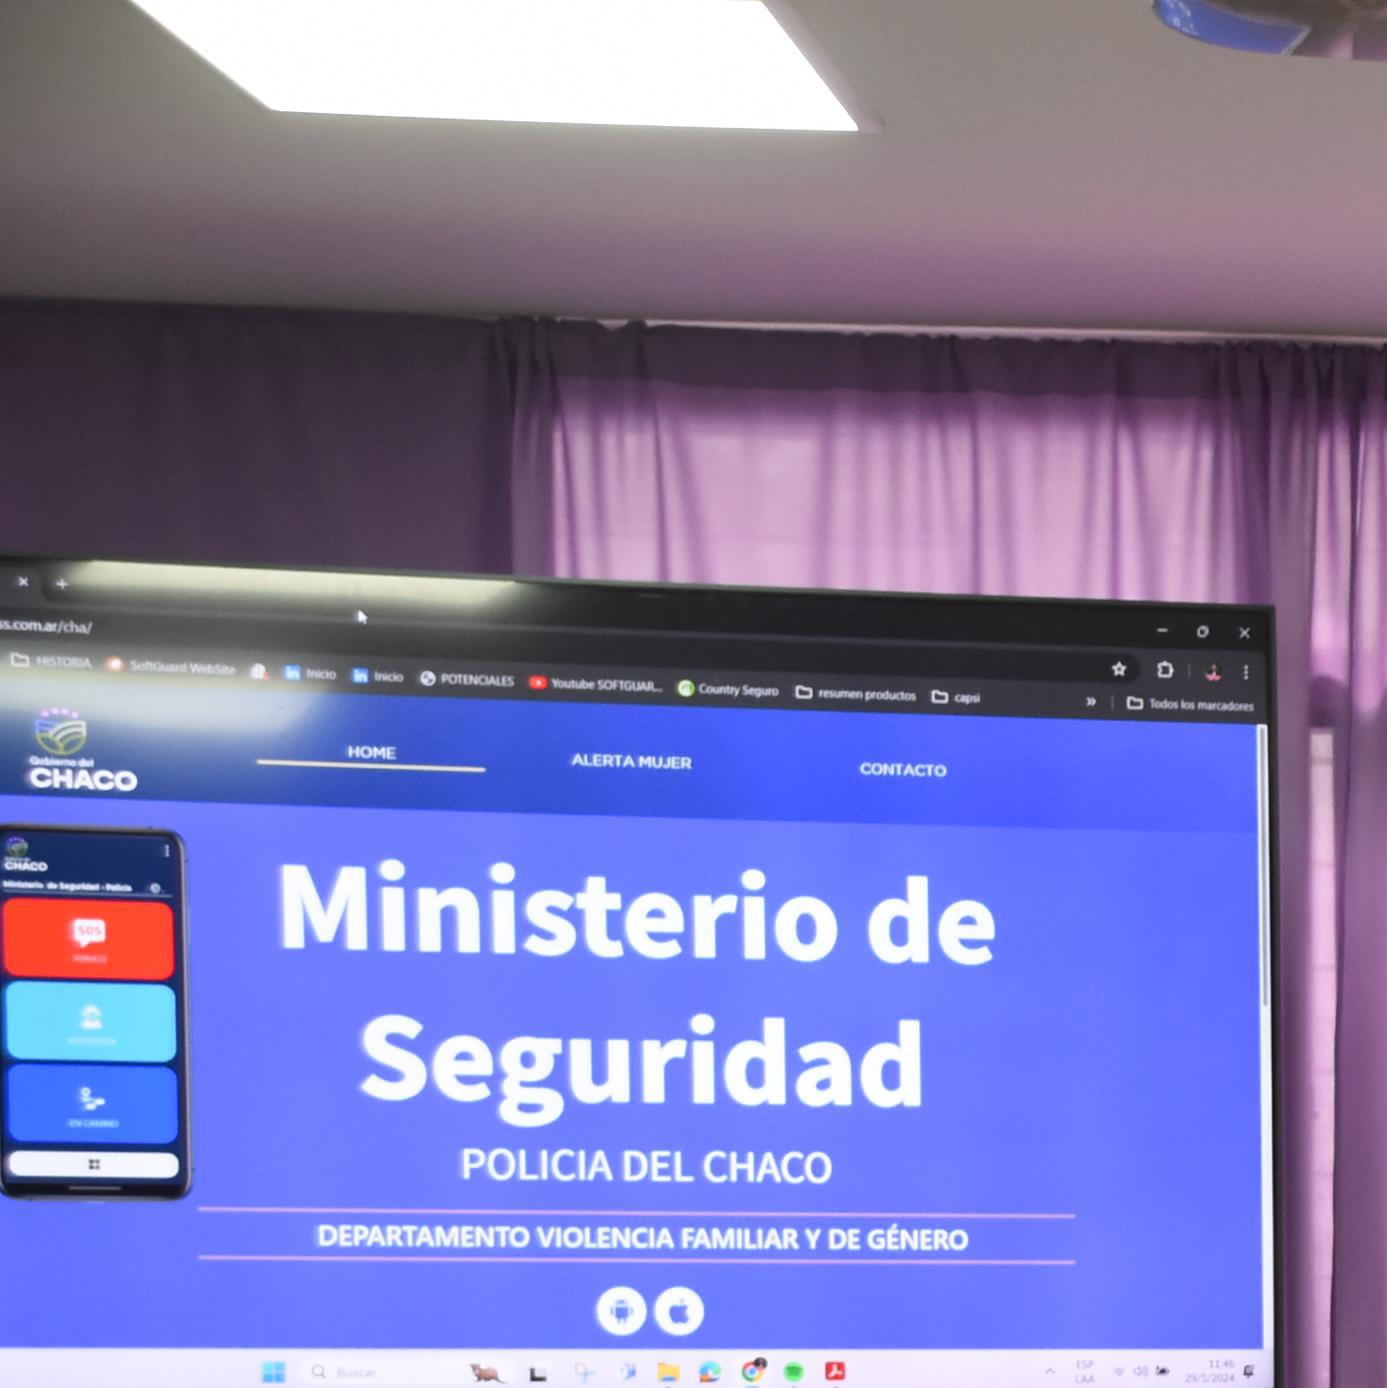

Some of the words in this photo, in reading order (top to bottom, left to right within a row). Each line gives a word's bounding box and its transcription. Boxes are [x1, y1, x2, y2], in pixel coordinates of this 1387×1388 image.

[307, 668, 336, 680] Inicio
[375, 671, 404, 683] Inicio
[441, 673, 515, 687] POTENCIALES
[552, 677, 595, 690] Youtube
[699, 683, 739, 697] Country
[743, 685, 779, 698] Seguro
[819, 688, 863, 699] resumen
[865, 689, 916, 703] productos
[1150, 698, 1178, 709] Todos
[1181, 699, 1195, 710] los
[1197, 700, 1255, 712] marcadores
[347, 745, 396, 760] HOME
[571, 752, 635, 769] ALERTA
[638, 755, 692, 770] MUJER
[859, 761, 947, 778] CONTACTO
[29, 767, 138, 791] CHACO
[4, 861, 48, 872] CHACO
[280, 858, 838, 963] Ministerio
[868, 875, 996, 966] de
[360, 1012, 922, 1127] Seguridad
[461, 1147, 613, 1181] POLICIA
[623, 1149, 694, 1182] DEL
[703, 1150, 833, 1184] CHACO
[318, 1224, 530, 1248] DEPARTAMENTO
[537, 1226, 674, 1249] VIOLENCIA
[681, 1227, 798, 1249] FAMILIAR
[804, 1228, 821, 1249] Y
[828, 1228, 860, 1250] DE
[867, 1223, 969, 1250] GÉNERO
